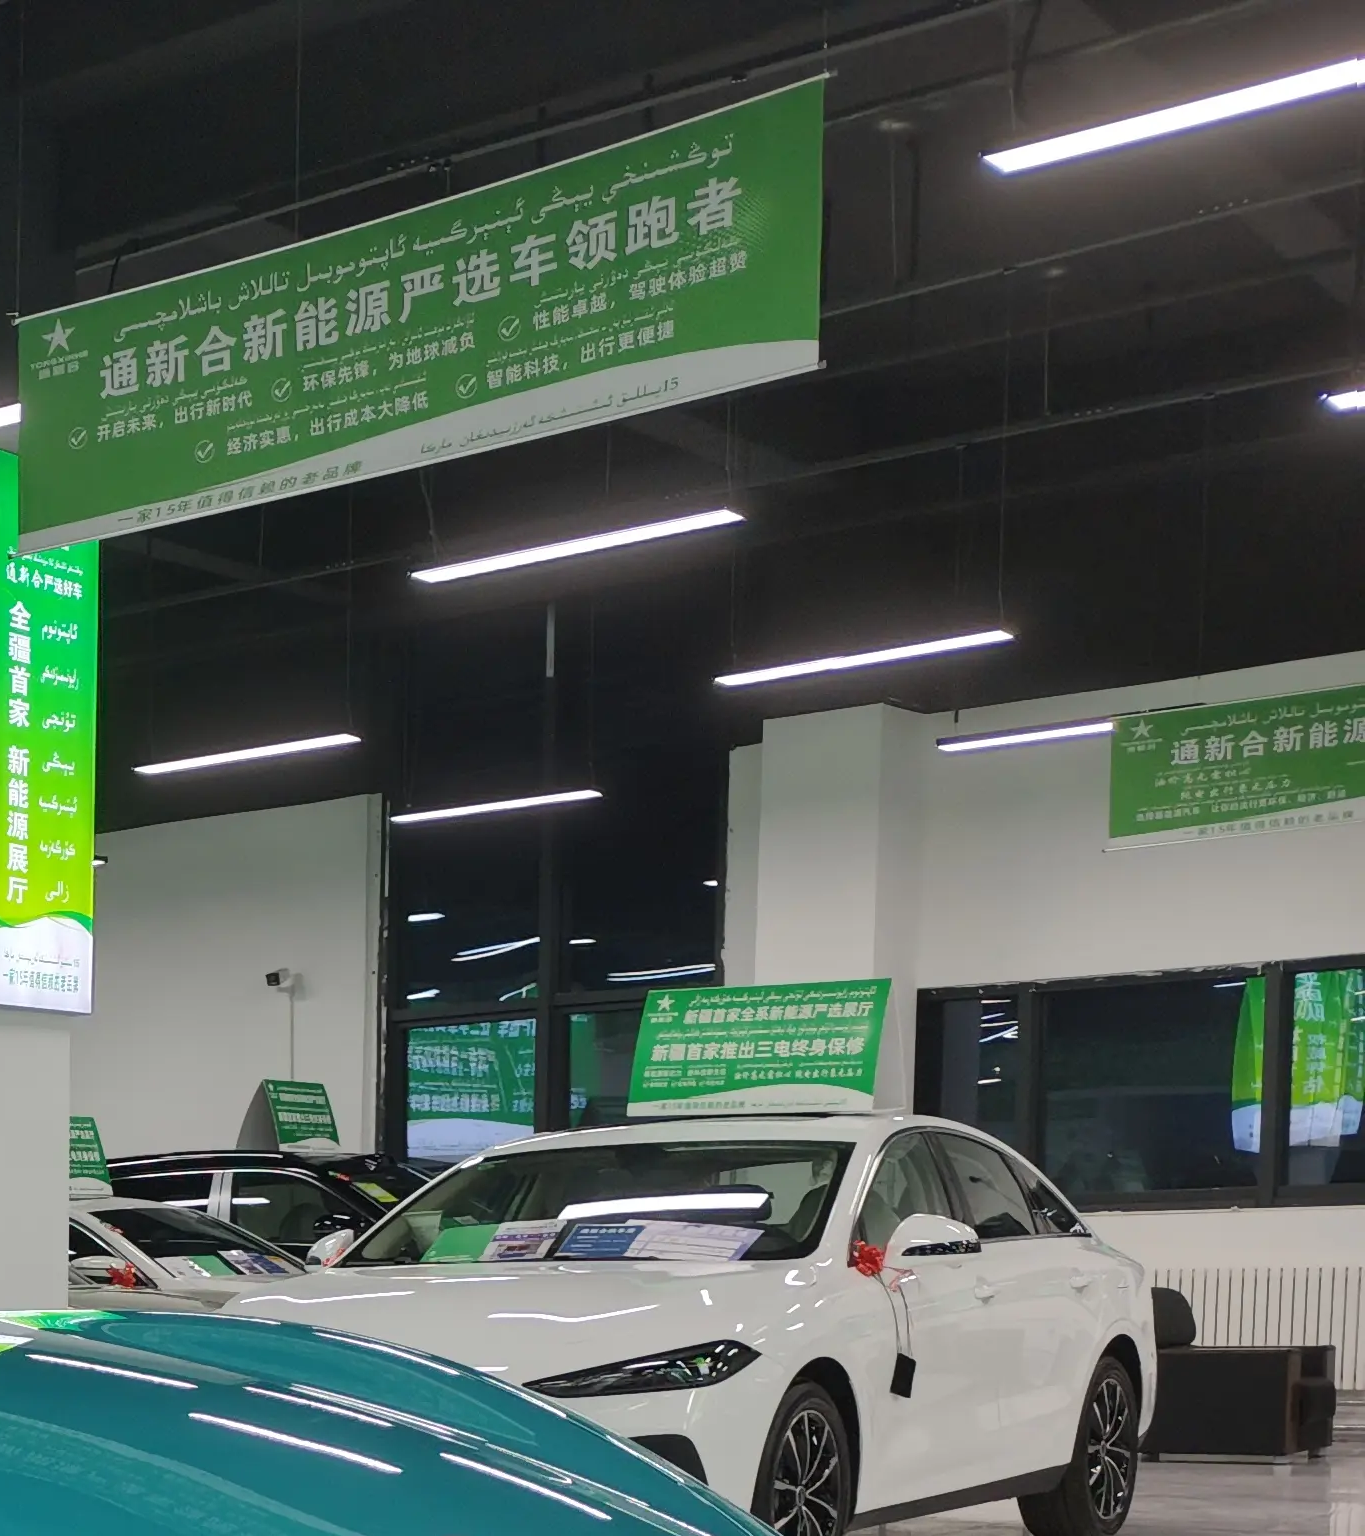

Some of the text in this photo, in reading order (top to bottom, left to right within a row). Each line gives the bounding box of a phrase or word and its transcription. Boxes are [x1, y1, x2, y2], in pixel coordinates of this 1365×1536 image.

[99, 176, 742, 399] 通新合新能源严选车领跑者
[227, 271, 290, 311] تاللاش
[532, 249, 748, 331] 性能卓越，驾驶体验超赞
[302, 331, 476, 393] 环保先锋，为地球减负
[486, 319, 675, 390] 智能科技，出行更便捷
[96, 390, 253, 443] 开启未来，出行新时代
[226, 391, 429, 456] 经济实惠，出行成本大降低
[117, 460, 363, 523] 一家15年值得信赖的老品牌
[6, 600, 32, 904] 全疆首家 新能源展厅
[651, 1037, 865, 1062] 新疆首家推出三电终身保修
